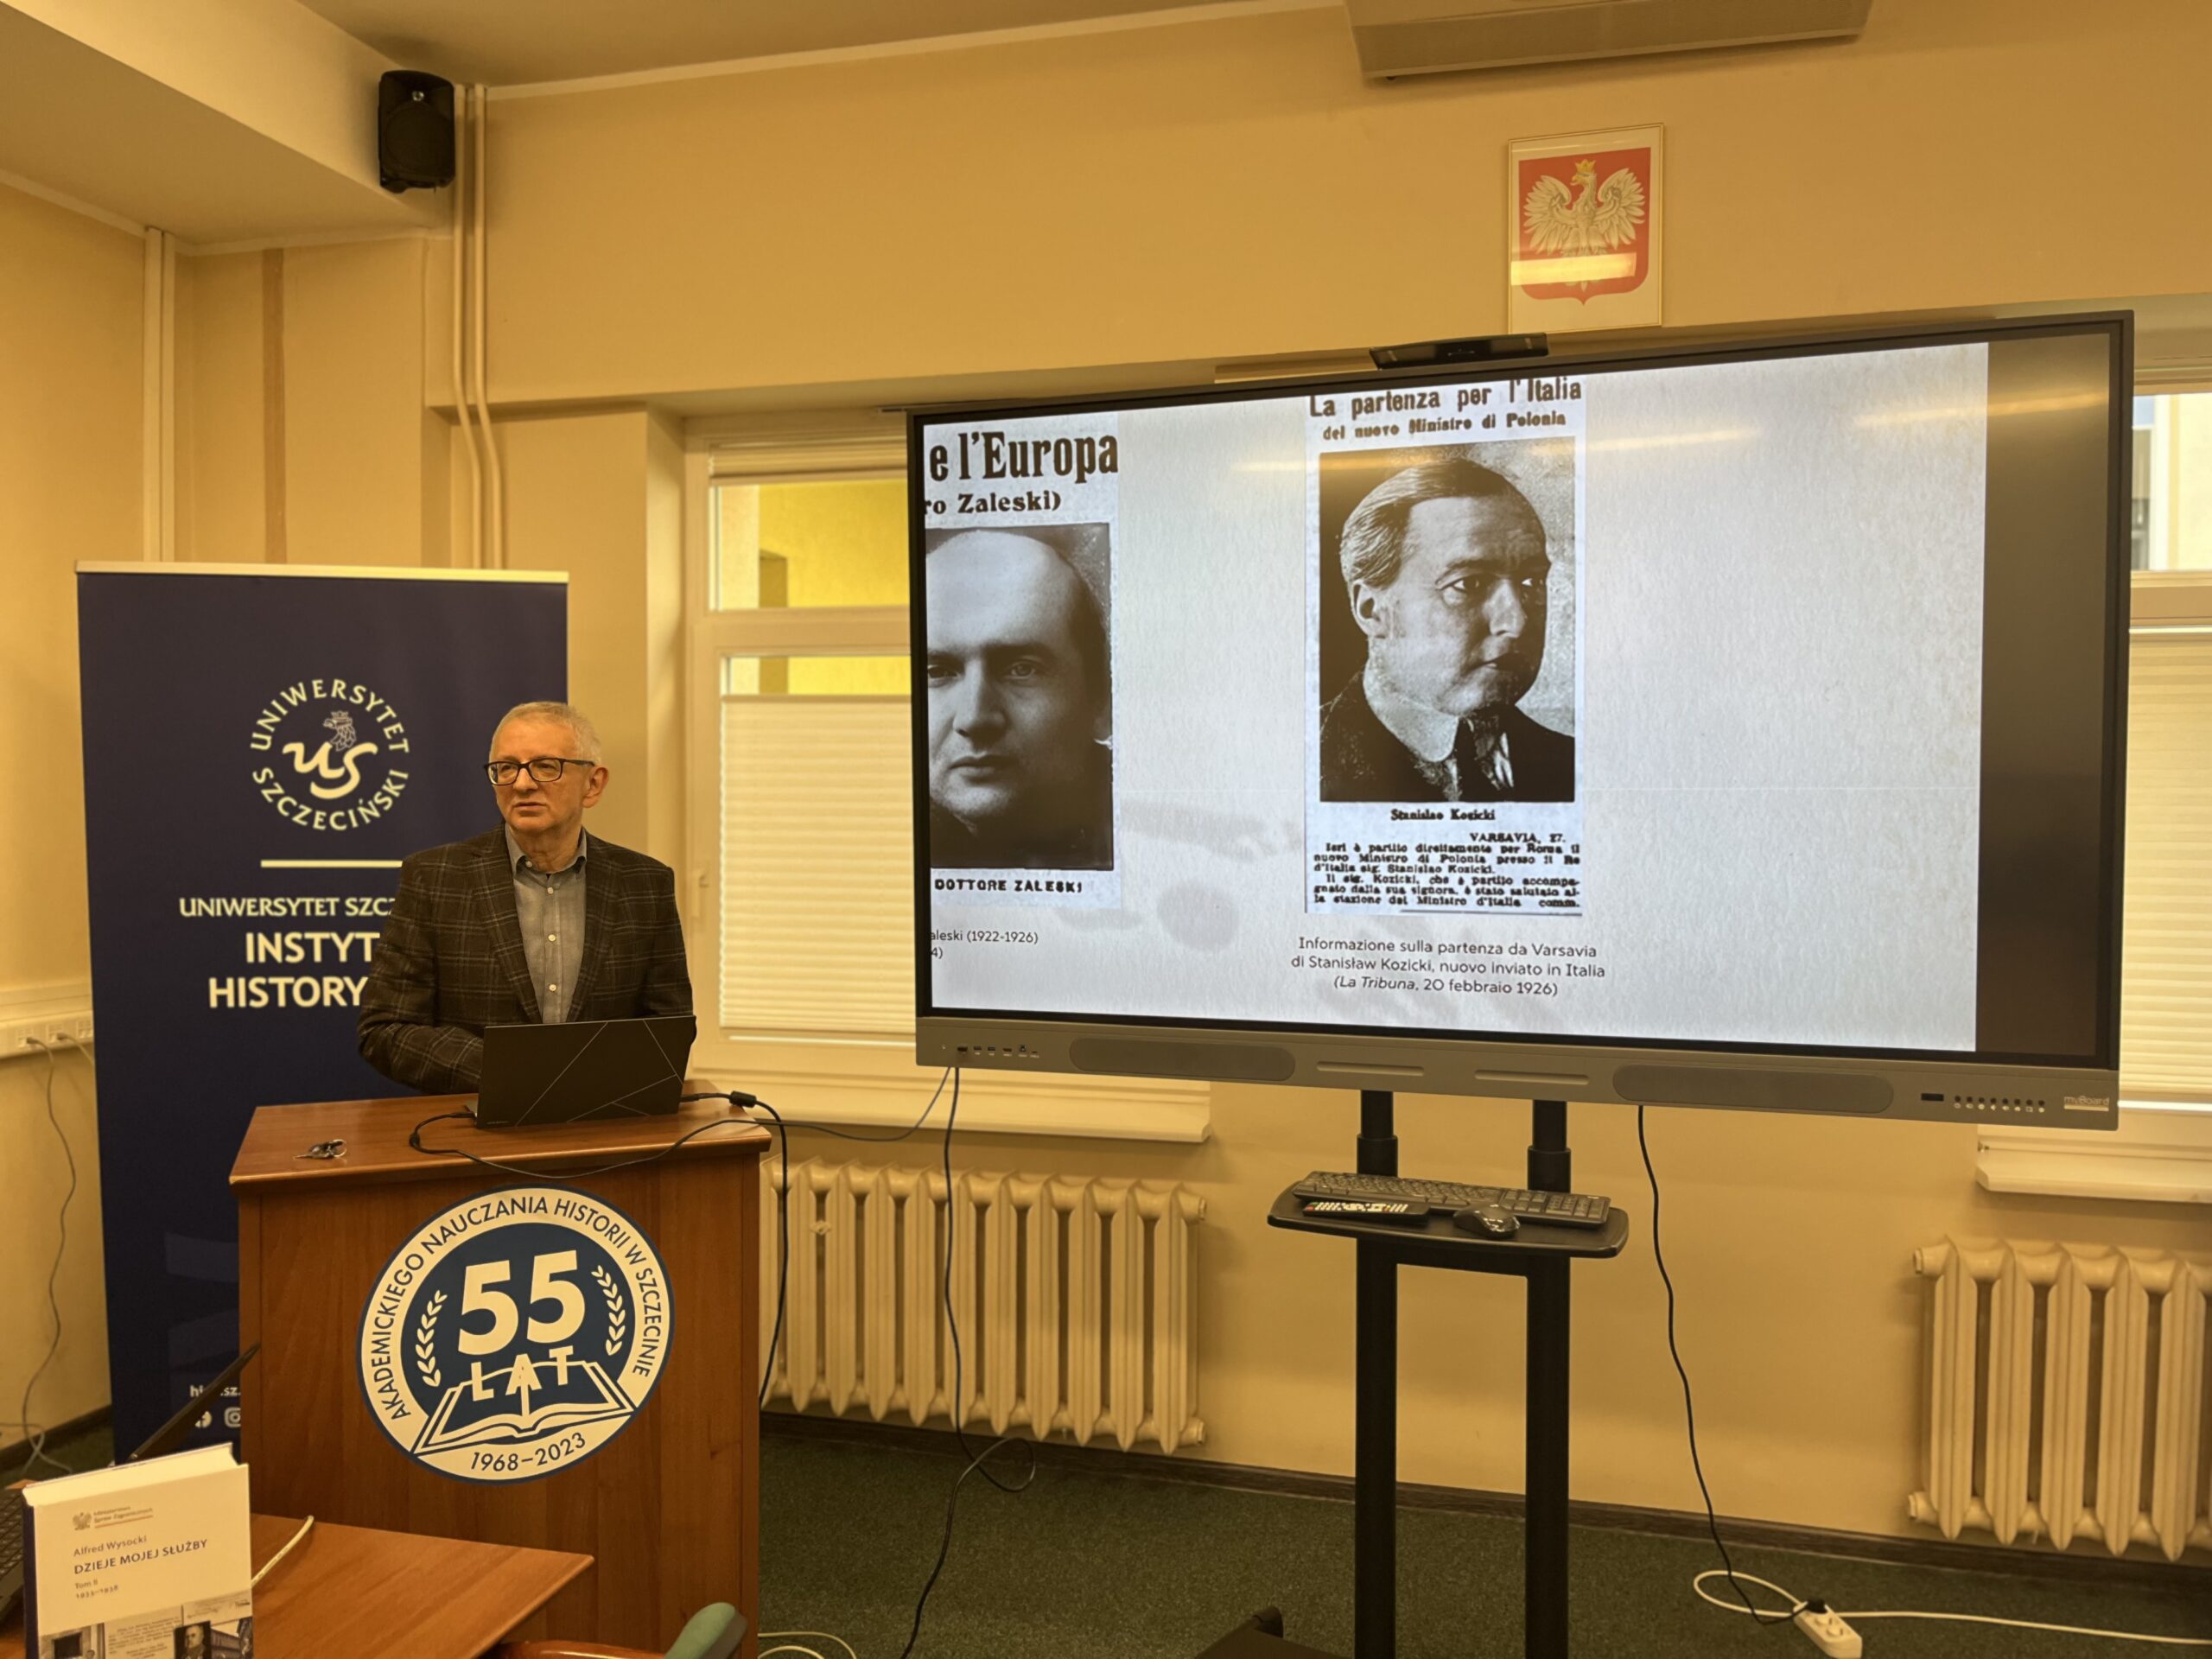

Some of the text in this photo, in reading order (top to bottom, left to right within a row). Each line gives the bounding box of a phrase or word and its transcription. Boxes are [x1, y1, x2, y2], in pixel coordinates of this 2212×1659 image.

[1310, 378, 1581, 420] La partenza per l'Italia
[1323, 411, 1566, 441] del nuovo Ministro di Polonia
[929, 431, 1118, 484] e l'Europa
[957, 491, 1061, 514] Zaleski)
[250, 678, 410, 753] UNIWERSYTET
[252, 766, 409, 831] SZCZECIŃSKI
[1390, 809, 1444, 821] Stanislao
[1313, 854, 1349, 862] nuovo
[1440, 855, 1486, 864] Polonia
[1497, 855, 1535, 865] presso
[1500, 845, 1520, 854] per
[934, 878, 1007, 892] DOTTORE
[179, 897, 340, 917] UNIWERSYTET
[245, 931, 380, 963] INSTYT
[931, 930, 1039, 944] aleski (1922-1926)
[1299, 937, 1597, 957] Informazione sulla partenza da Varsavia
[1291, 954, 1605, 978] di Stanisław Kozicki, nuovo inviato in Italia
[208, 976, 369, 1008] HISTORY
[1333, 975, 1558, 997] (La Tribuna, 20 febbraio 1926)
[371, 1196, 662, 1421] AKADEMICKIEGO NAUCZANIA HISTORII W SZCZECINIE
[458, 1249, 586, 1356] 55
[470, 1345, 574, 1402] LAT
[73, 1535, 147, 1558] Alfred Wysocki
[74, 1539, 207, 1575] DZIEJE MOJEJ SŁUŻBY
[74, 1580, 92, 1590] Tom
